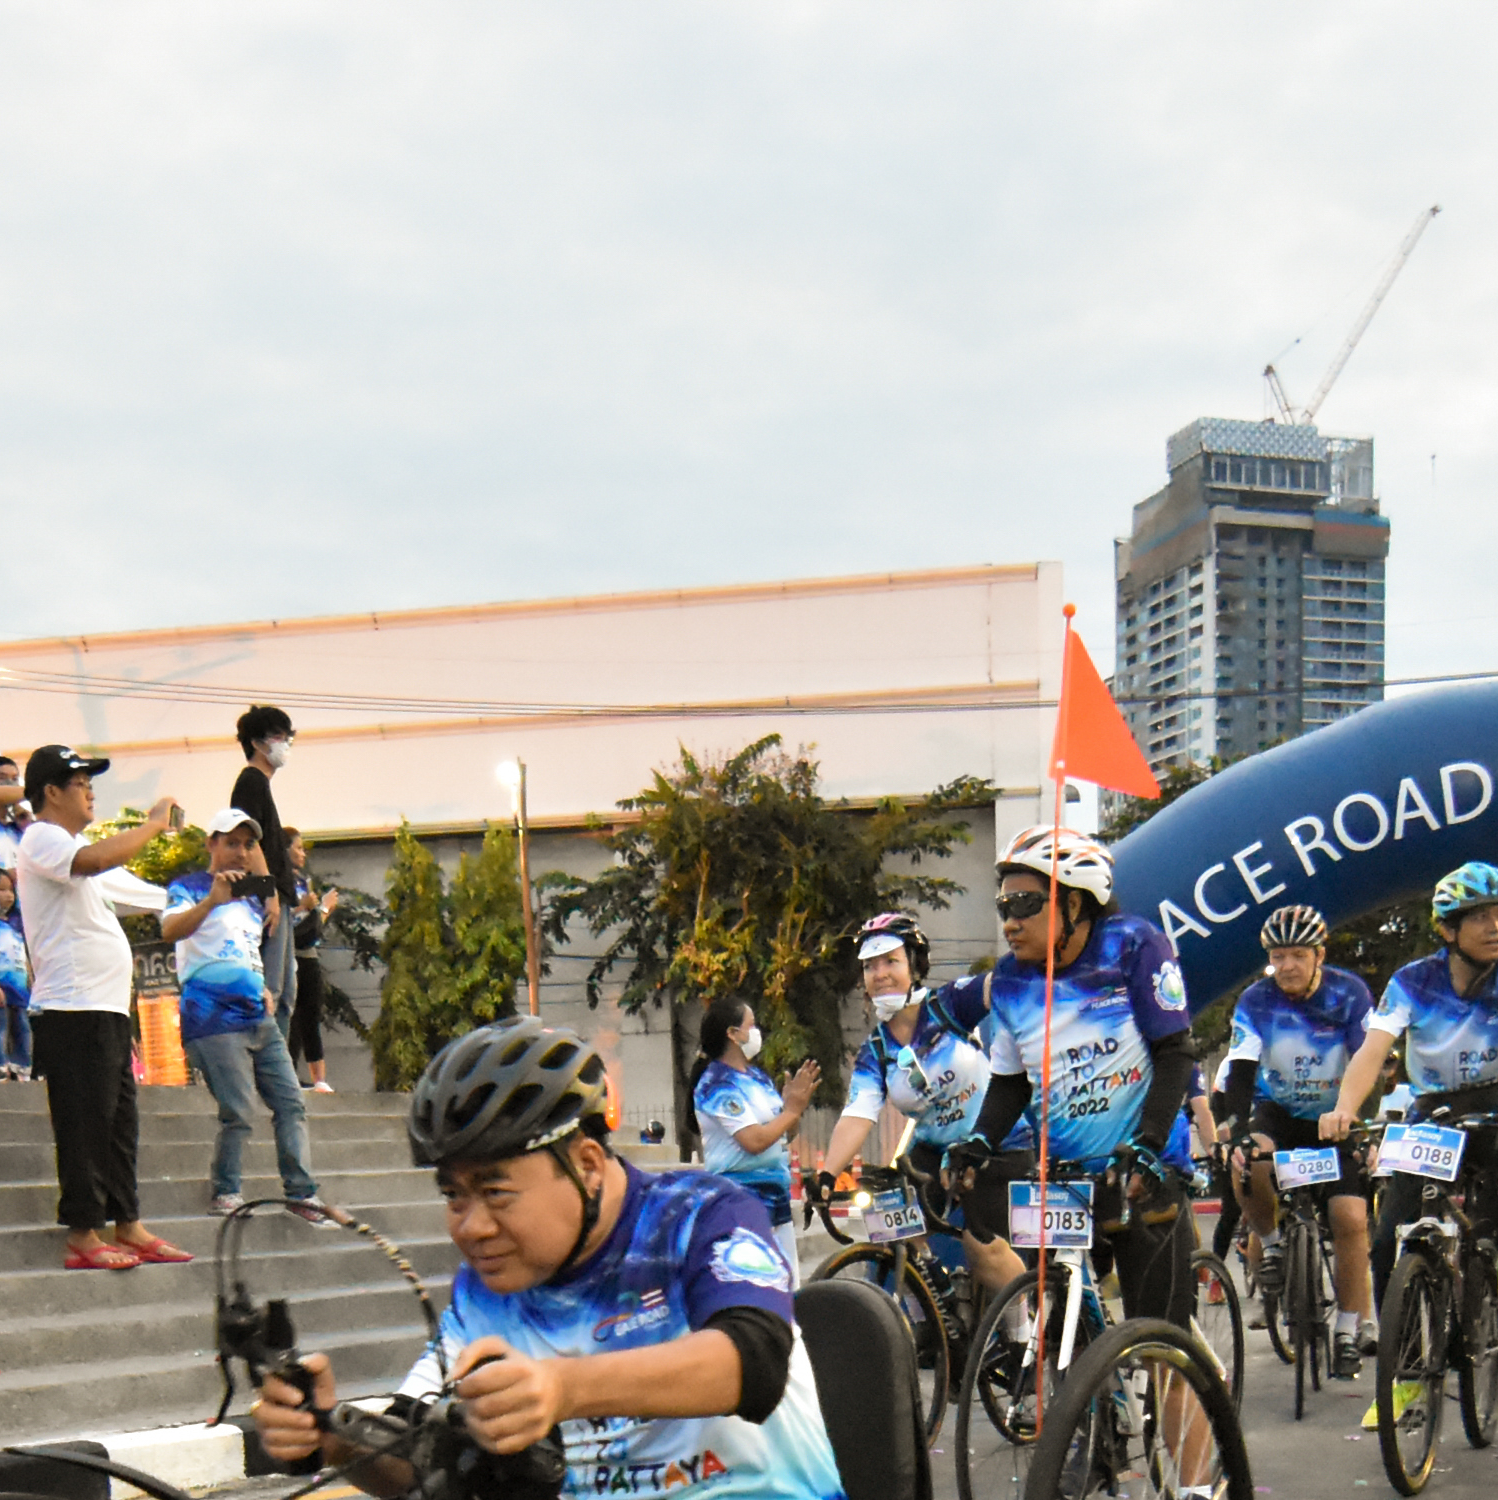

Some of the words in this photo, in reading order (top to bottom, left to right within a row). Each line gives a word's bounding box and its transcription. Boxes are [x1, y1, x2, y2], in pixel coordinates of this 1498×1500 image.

[1158, 840, 1288, 957] ACE
[1283, 761, 1494, 878] ROAD
[1067, 1037, 1119, 1064] ROAD
[1459, 1047, 1498, 1065] ROAD
[1069, 1063, 1096, 1082] TO
[1459, 1066, 1480, 1081] TO
[1068, 1096, 1110, 1119] 2022
[1411, 1145, 1453, 1166] 0188
[1298, 1159, 1333, 1175] 0280
[884, 1208, 919, 1229] 0814
[1043, 1211, 1086, 1231] 0183
[594, 1449, 728, 1496] PATTAYA
